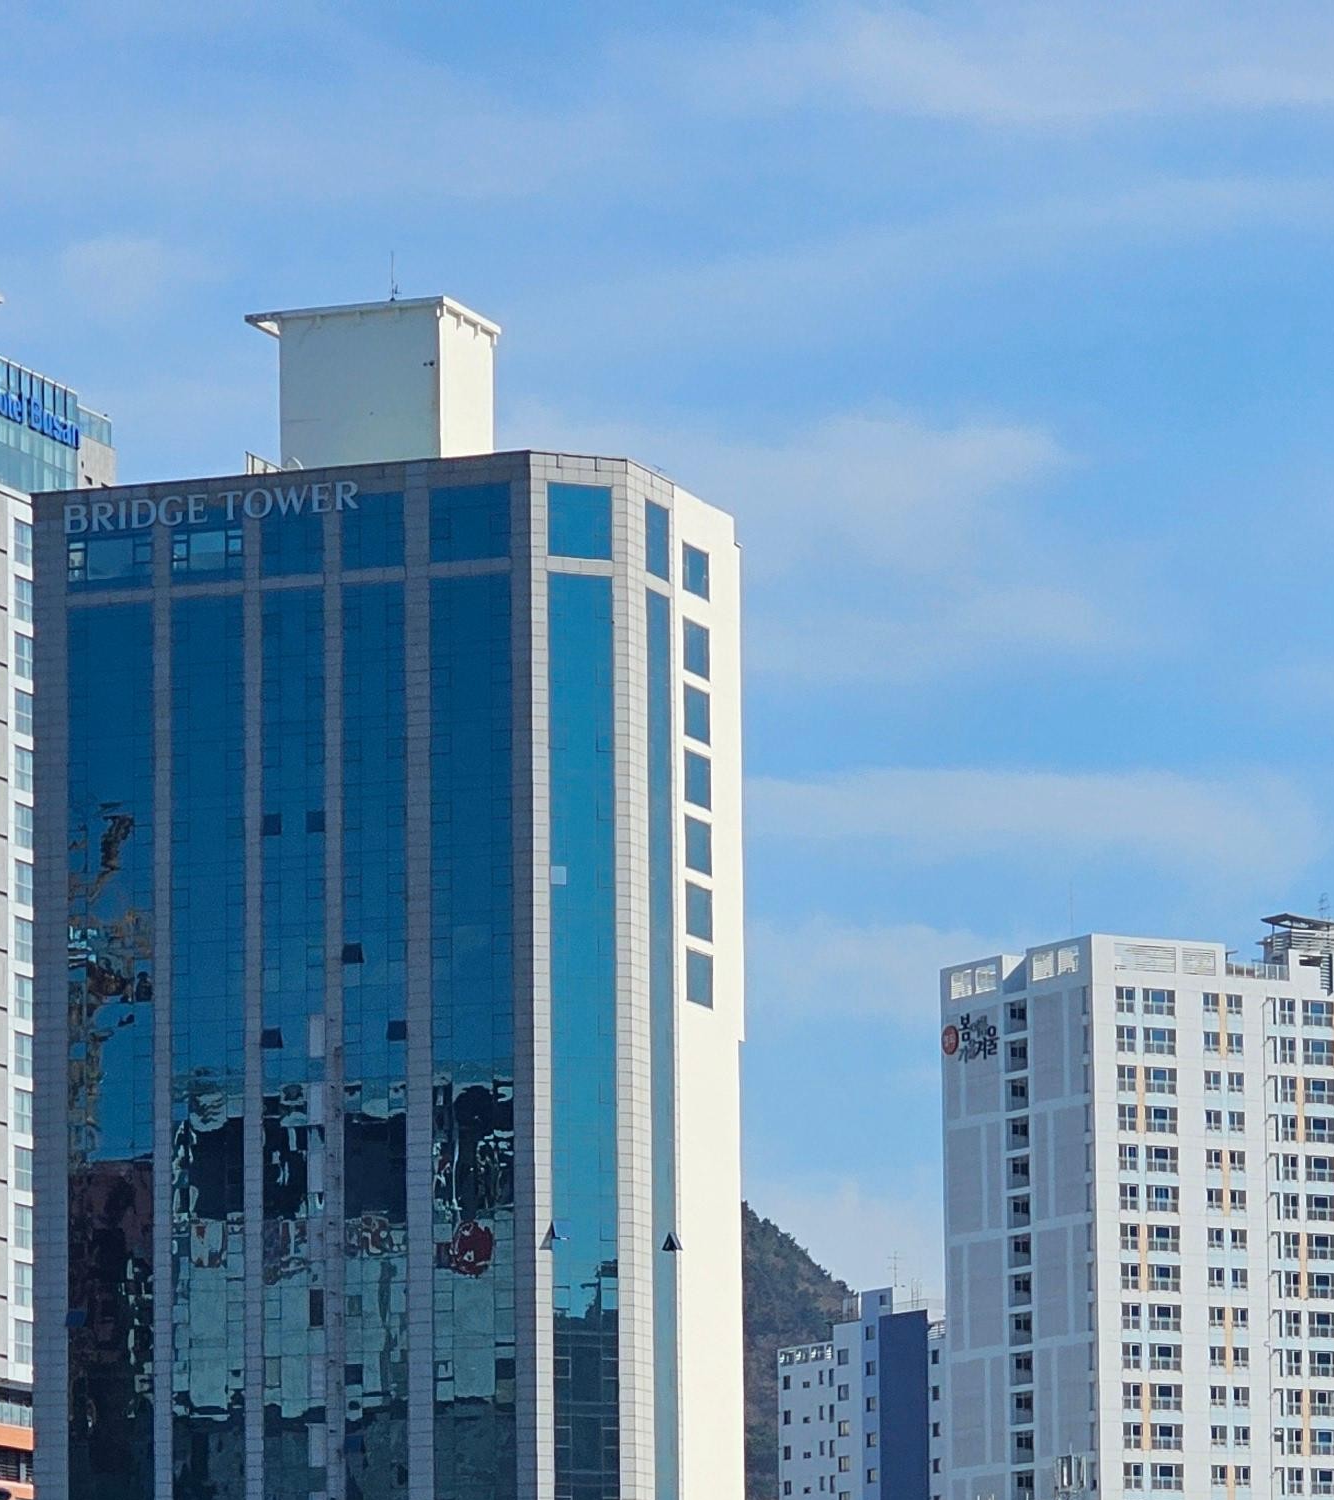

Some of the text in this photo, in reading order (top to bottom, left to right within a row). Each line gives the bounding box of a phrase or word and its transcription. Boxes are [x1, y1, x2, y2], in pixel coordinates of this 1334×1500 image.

[28, 397, 80, 449] Busan
[63, 480, 360, 534] BRIDGE TOWER
